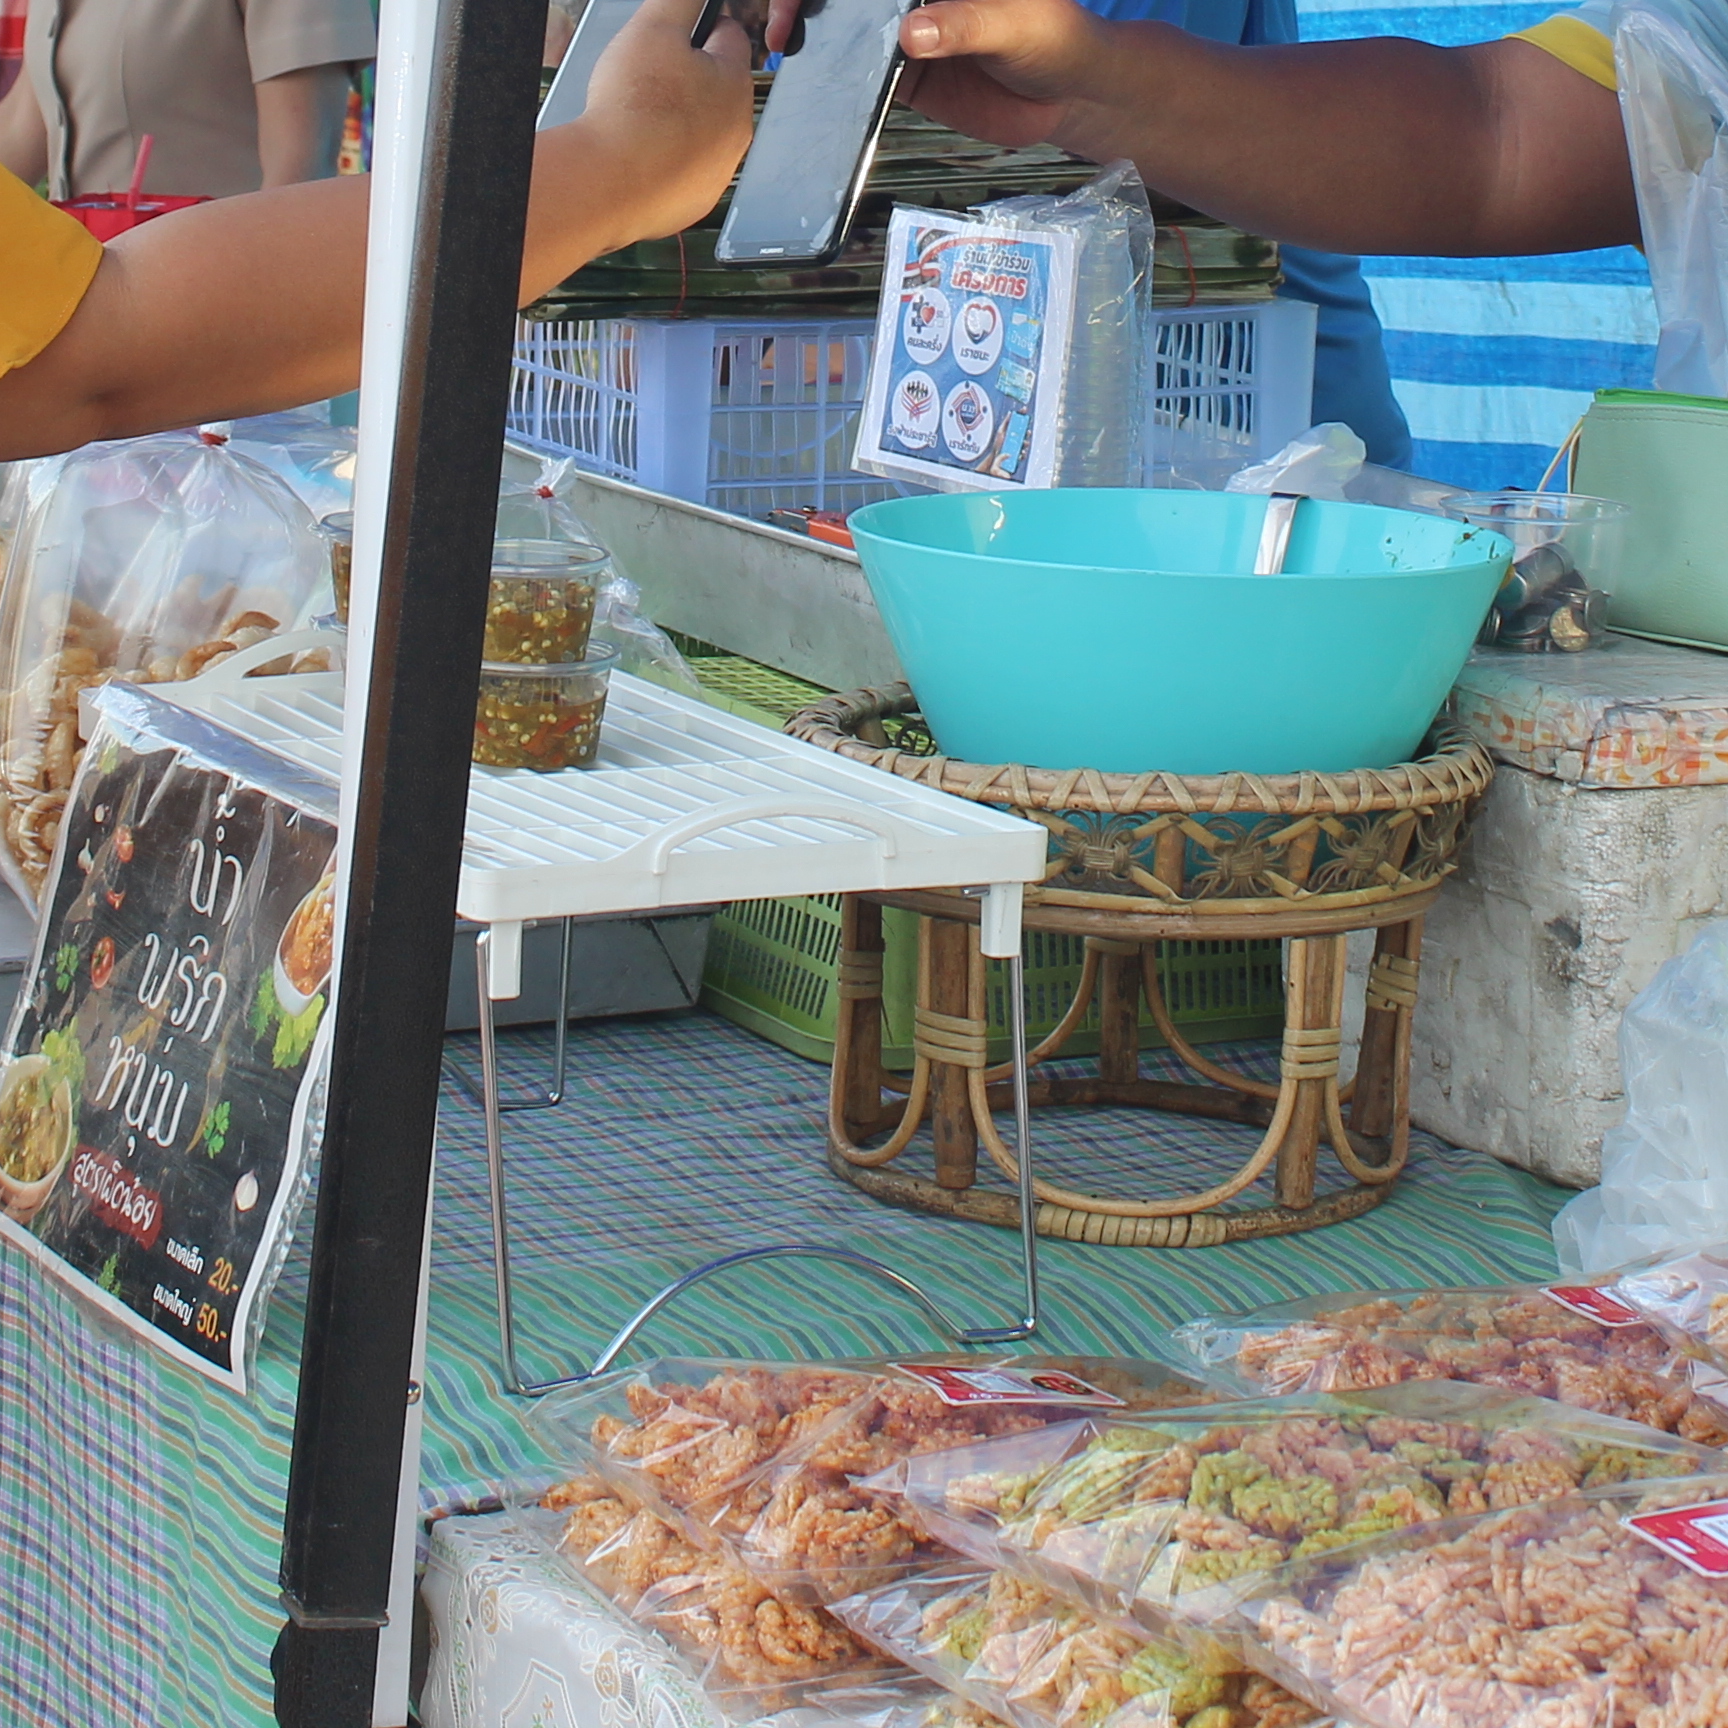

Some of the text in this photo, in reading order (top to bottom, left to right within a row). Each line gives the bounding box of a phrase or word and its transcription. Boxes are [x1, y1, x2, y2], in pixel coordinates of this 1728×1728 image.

[951, 262, 1027, 298] โครงการ
[907, 333, 943, 353] คนละครึ่ง
[959, 346, 990, 362] เราชนะ
[189, 793, 245, 927] น้ำ
[137, 931, 228, 1044] พริก
[95, 1035, 189, 1158] หนุ่ม
[165, 1237, 241, 1297] ขนาดเล็ก 20.-
[152, 1282, 230, 1344] ขนาดใหญ่ 50.-
